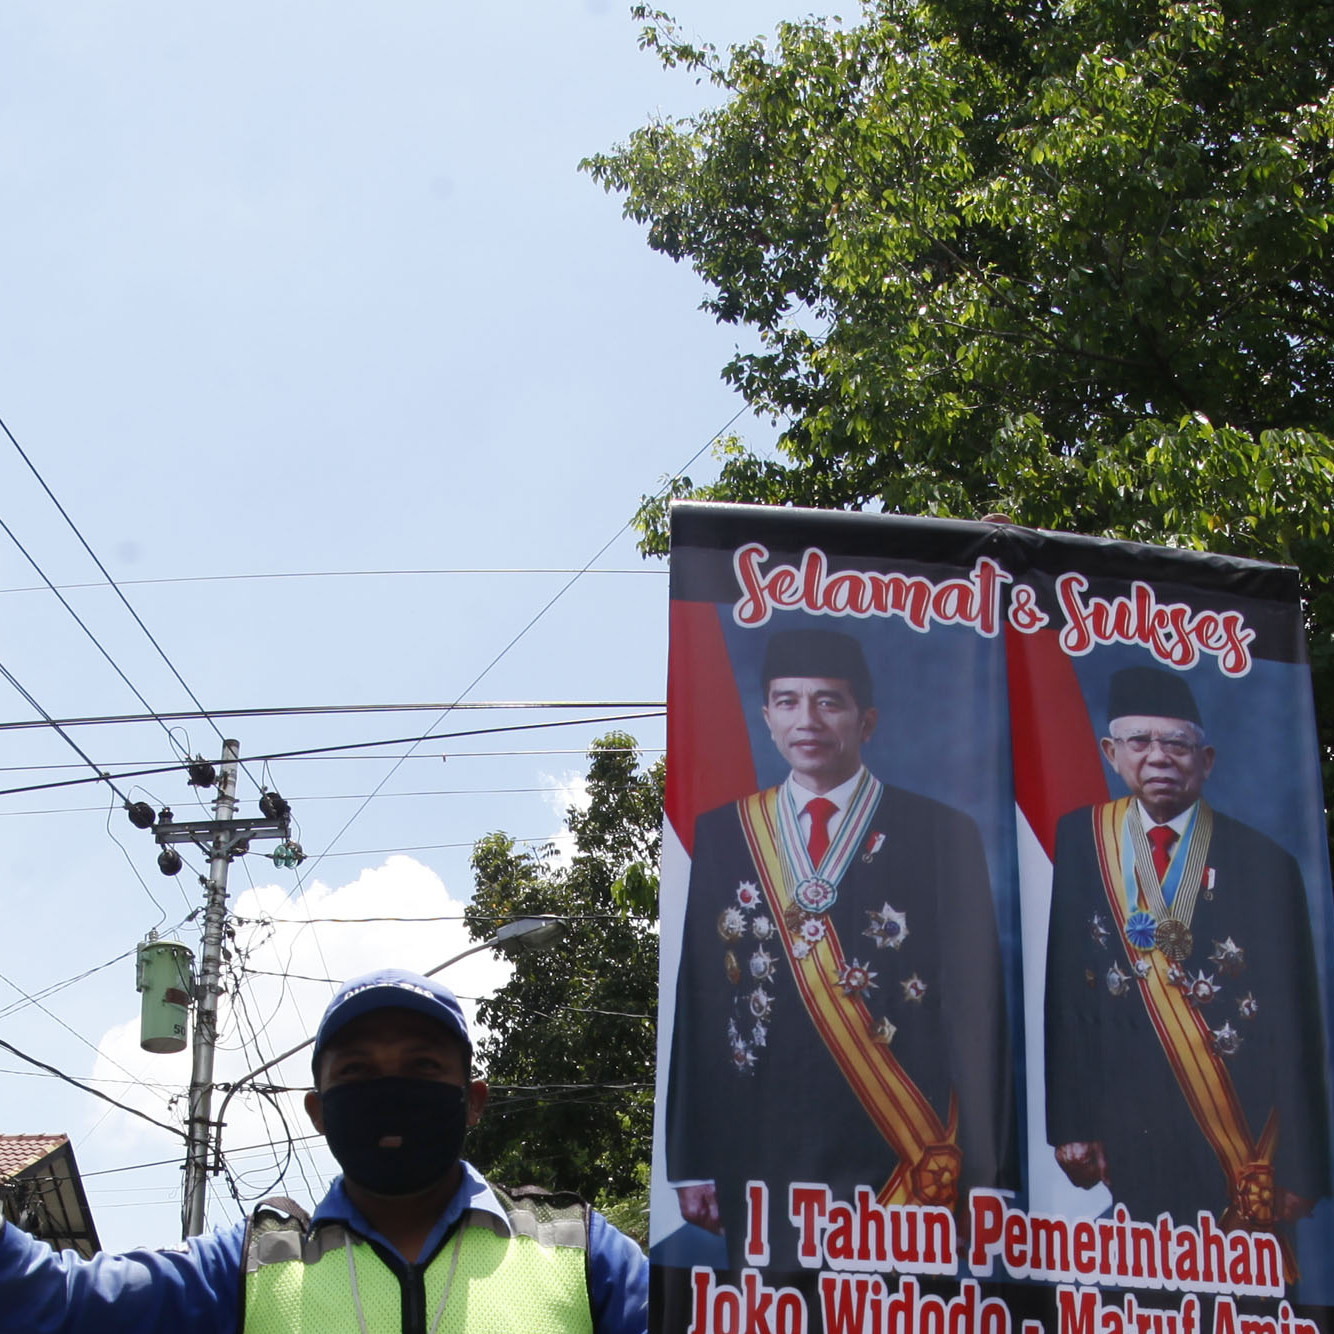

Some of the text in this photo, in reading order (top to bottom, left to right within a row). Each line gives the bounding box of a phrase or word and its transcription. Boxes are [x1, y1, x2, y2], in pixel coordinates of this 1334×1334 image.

[734, 544, 1255, 677] Selamat & Sukses
[173, 1024, 186, 1036] 50
[789, 1183, 957, 1275] Tahun
[969, 1188, 1284, 1297] Pemerintahan
